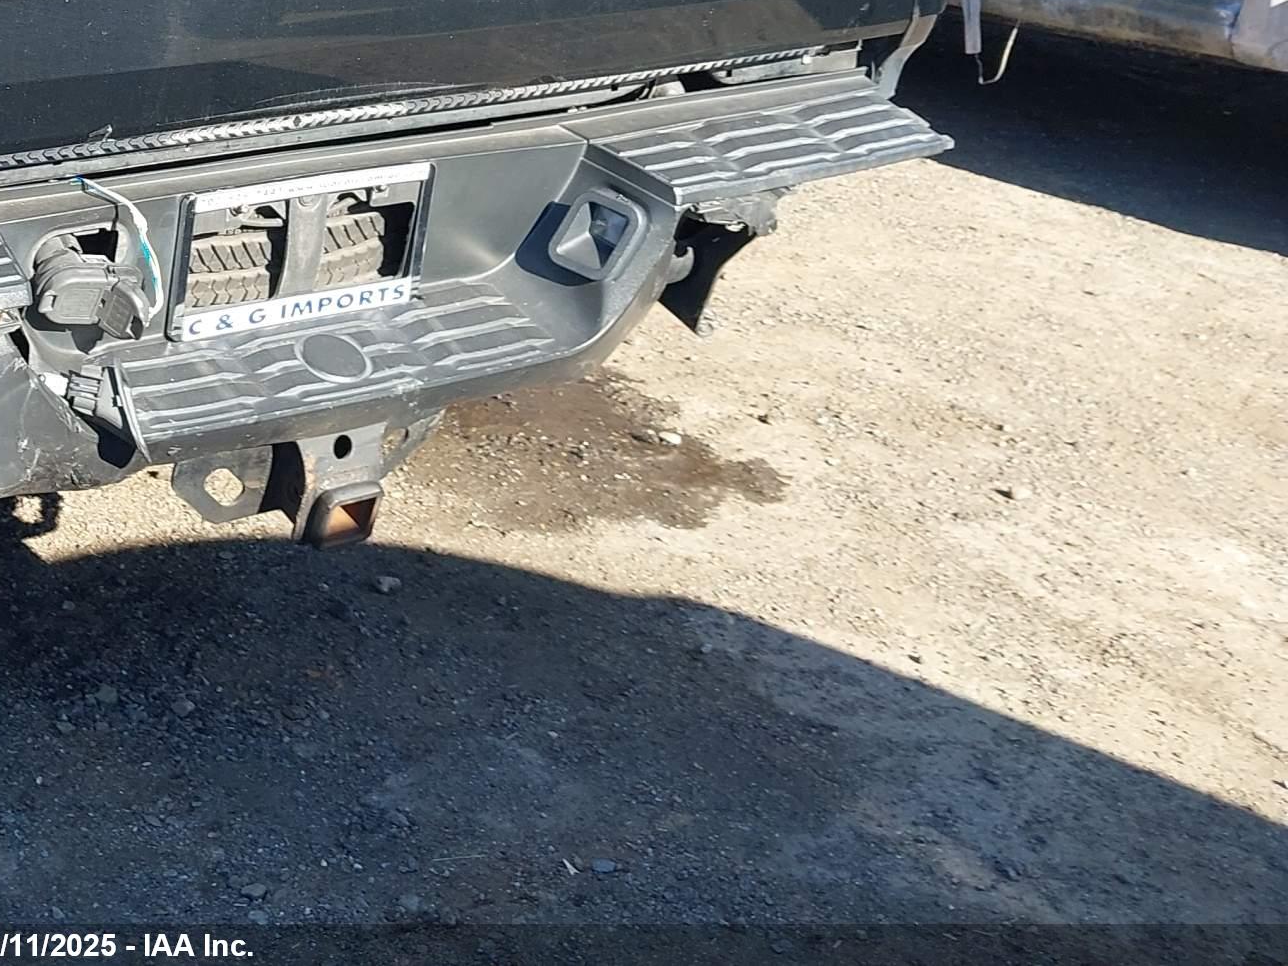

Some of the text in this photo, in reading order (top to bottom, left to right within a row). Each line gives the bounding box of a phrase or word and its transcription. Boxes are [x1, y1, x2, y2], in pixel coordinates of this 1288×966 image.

[189, 284, 405, 335] C & G IMPORTS
